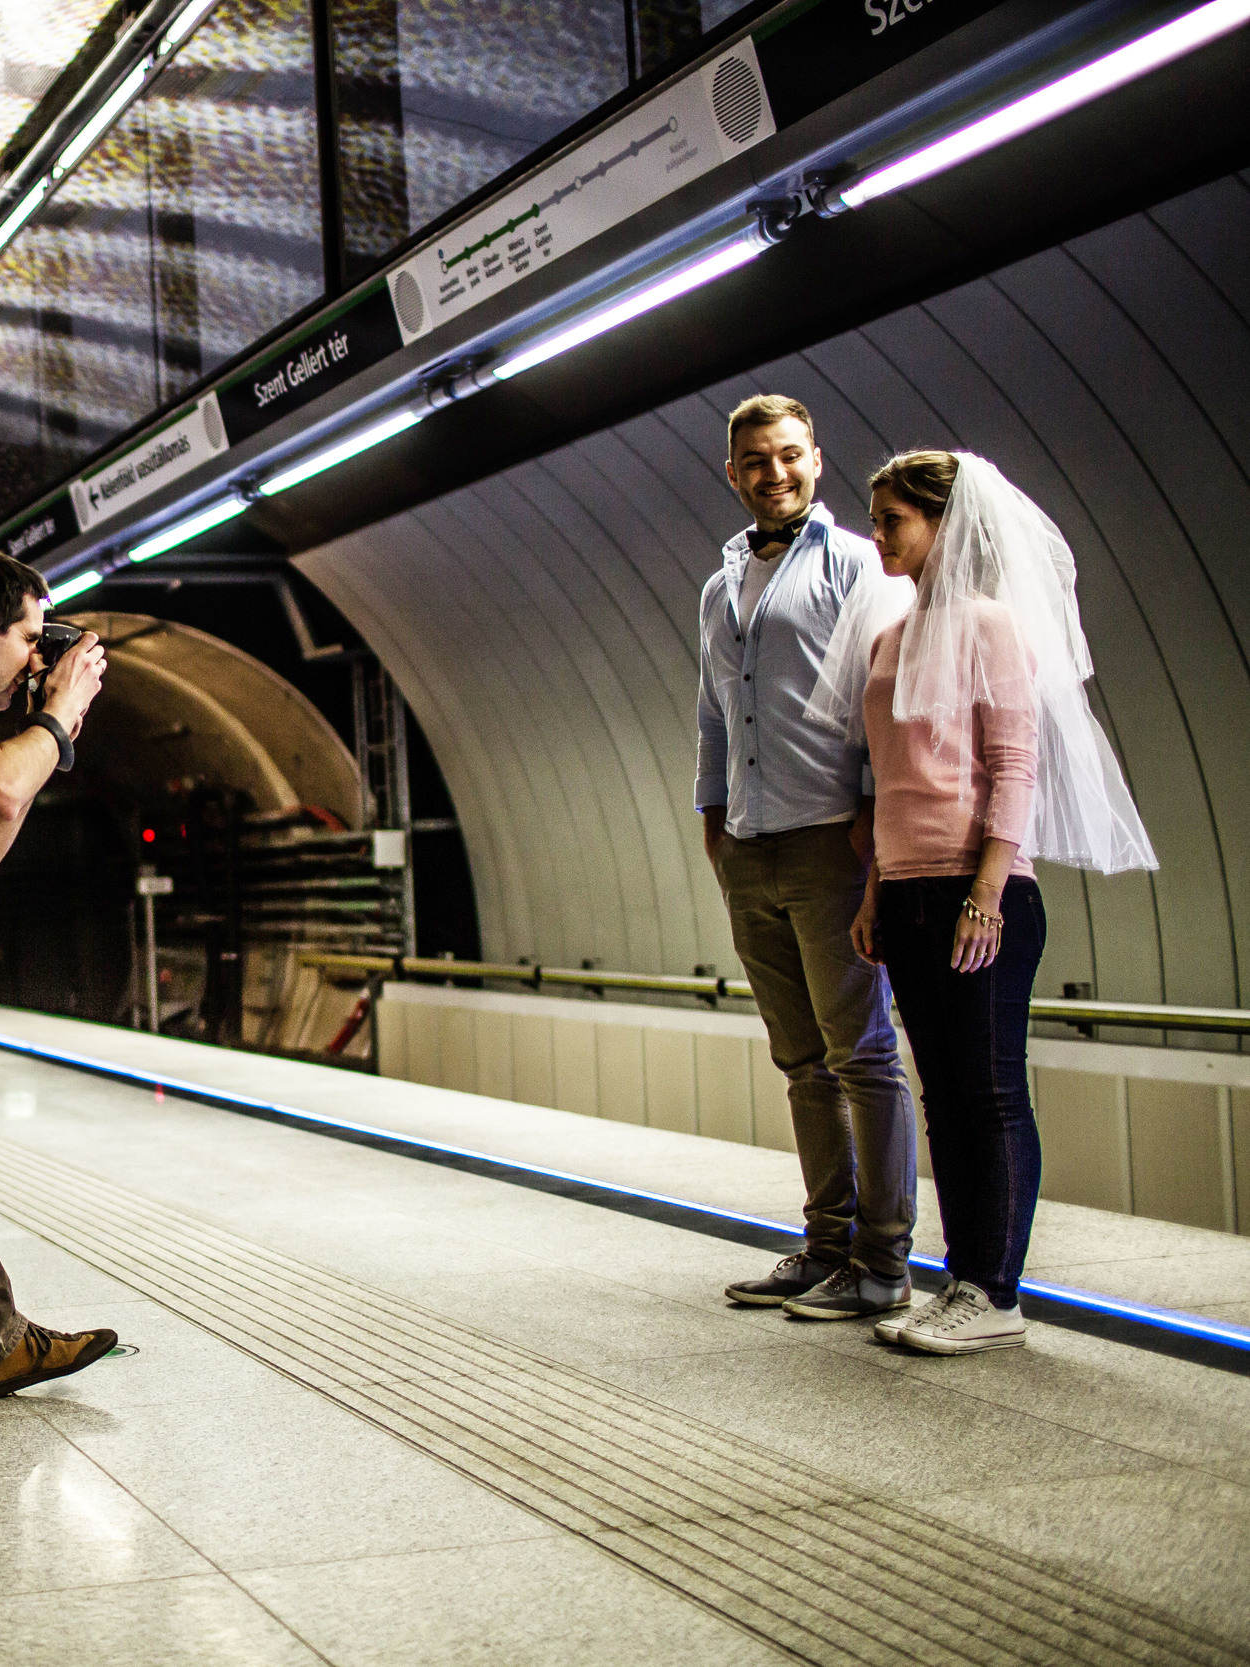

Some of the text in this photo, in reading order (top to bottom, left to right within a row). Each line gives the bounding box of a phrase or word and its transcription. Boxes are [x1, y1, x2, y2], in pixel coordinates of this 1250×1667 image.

[864, 0, 933, 36] Sz
[254, 330, 349, 407] Szent Gellért tér
